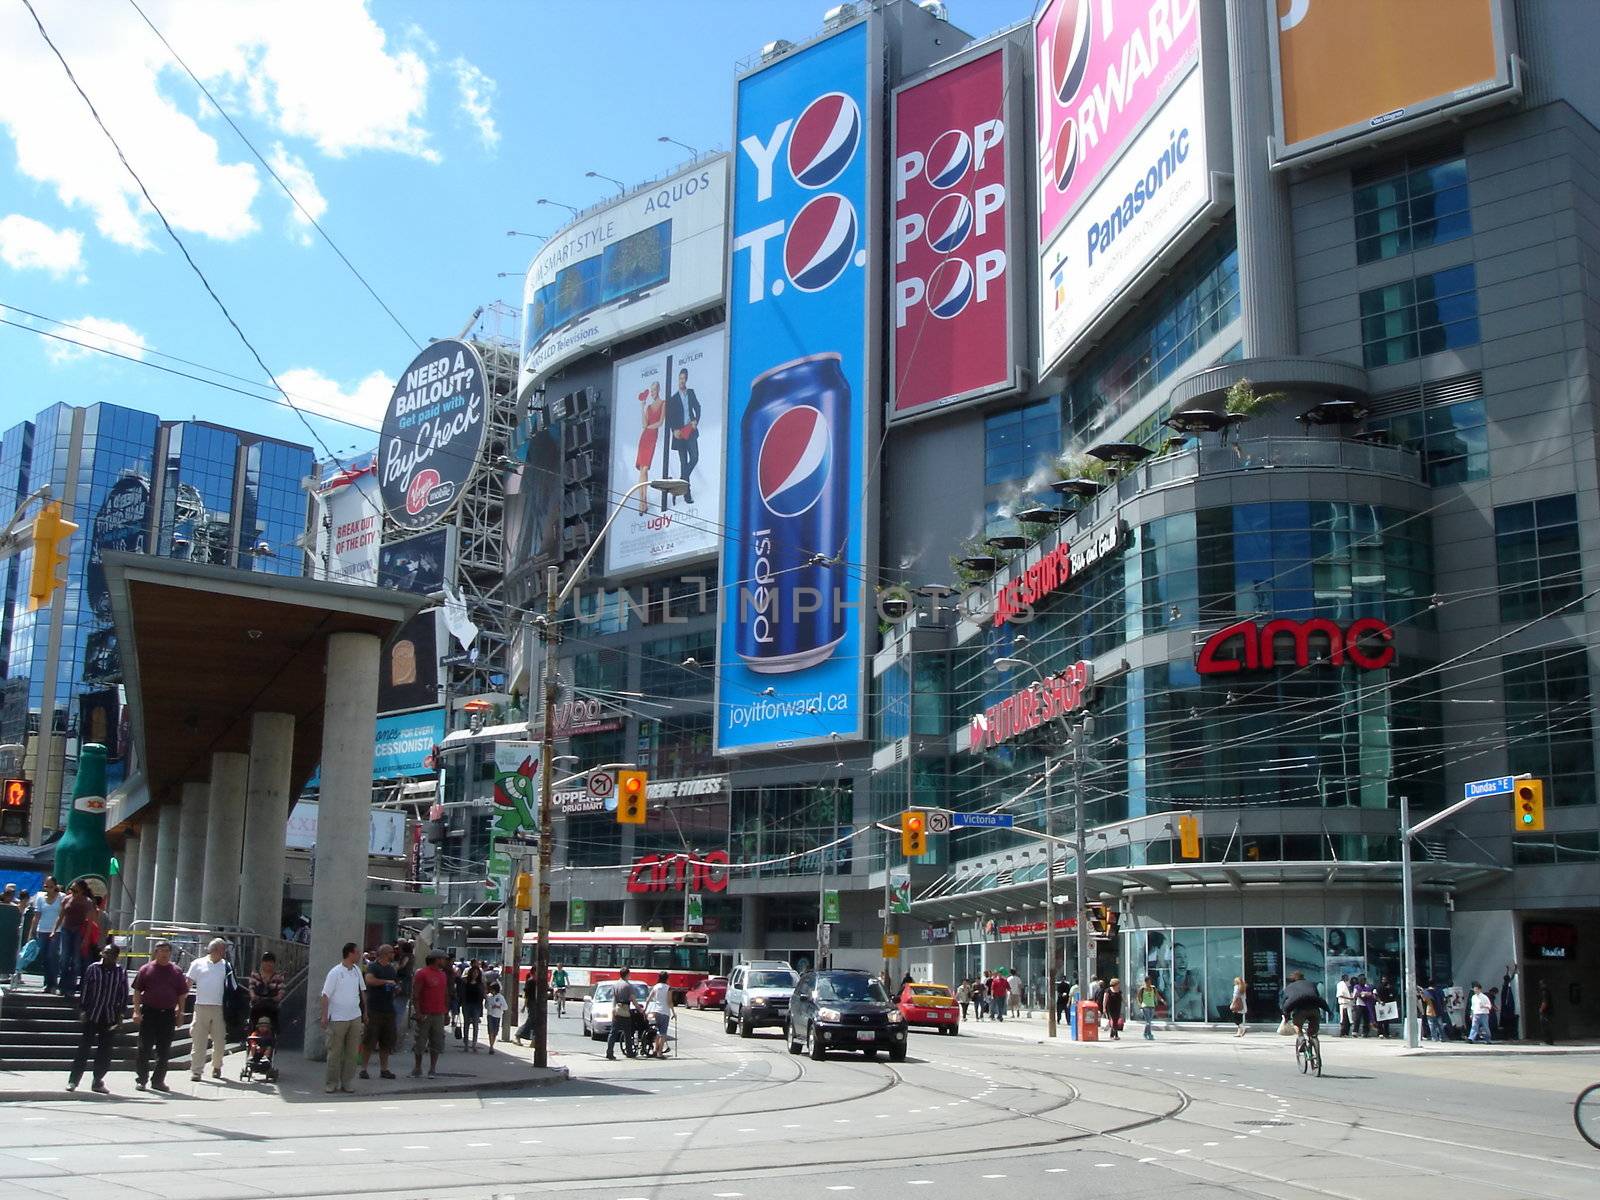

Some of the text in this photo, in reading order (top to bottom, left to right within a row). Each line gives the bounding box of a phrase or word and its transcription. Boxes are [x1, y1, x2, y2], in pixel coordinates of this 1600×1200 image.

[896, 119, 1005, 201] POP
[644, 171, 710, 215] AQUOS
[1087, 127, 1189, 268] Panasonic
[896, 183, 1006, 264] POP
[896, 249, 1007, 329] POP
[406, 350, 466, 392] NEED A
[395, 367, 475, 418] BAILOUT?
[399, 394, 465, 430] Get paid with
[337, 516, 375, 539] BREAK OUT
[647, 513, 673, 530] ugly
[336, 531, 376, 555] OF THE CITY
[650, 543, 665, 553] JULY
[752, 528, 775, 643] pepsi
[992, 575, 1022, 628] JACK
[1196, 617, 1395, 673] amc
[728, 692, 848, 729] joyitforward.ca
[984, 659, 1095, 748] FUTURE SHOP
[562, 801, 604, 813] DRUG MART
[676, 777, 723, 797] FITNESS
[1471, 782, 1497, 795] Dundas
[1503, 778, 1509, 789] E
[963, 814, 996, 825] Victoria
